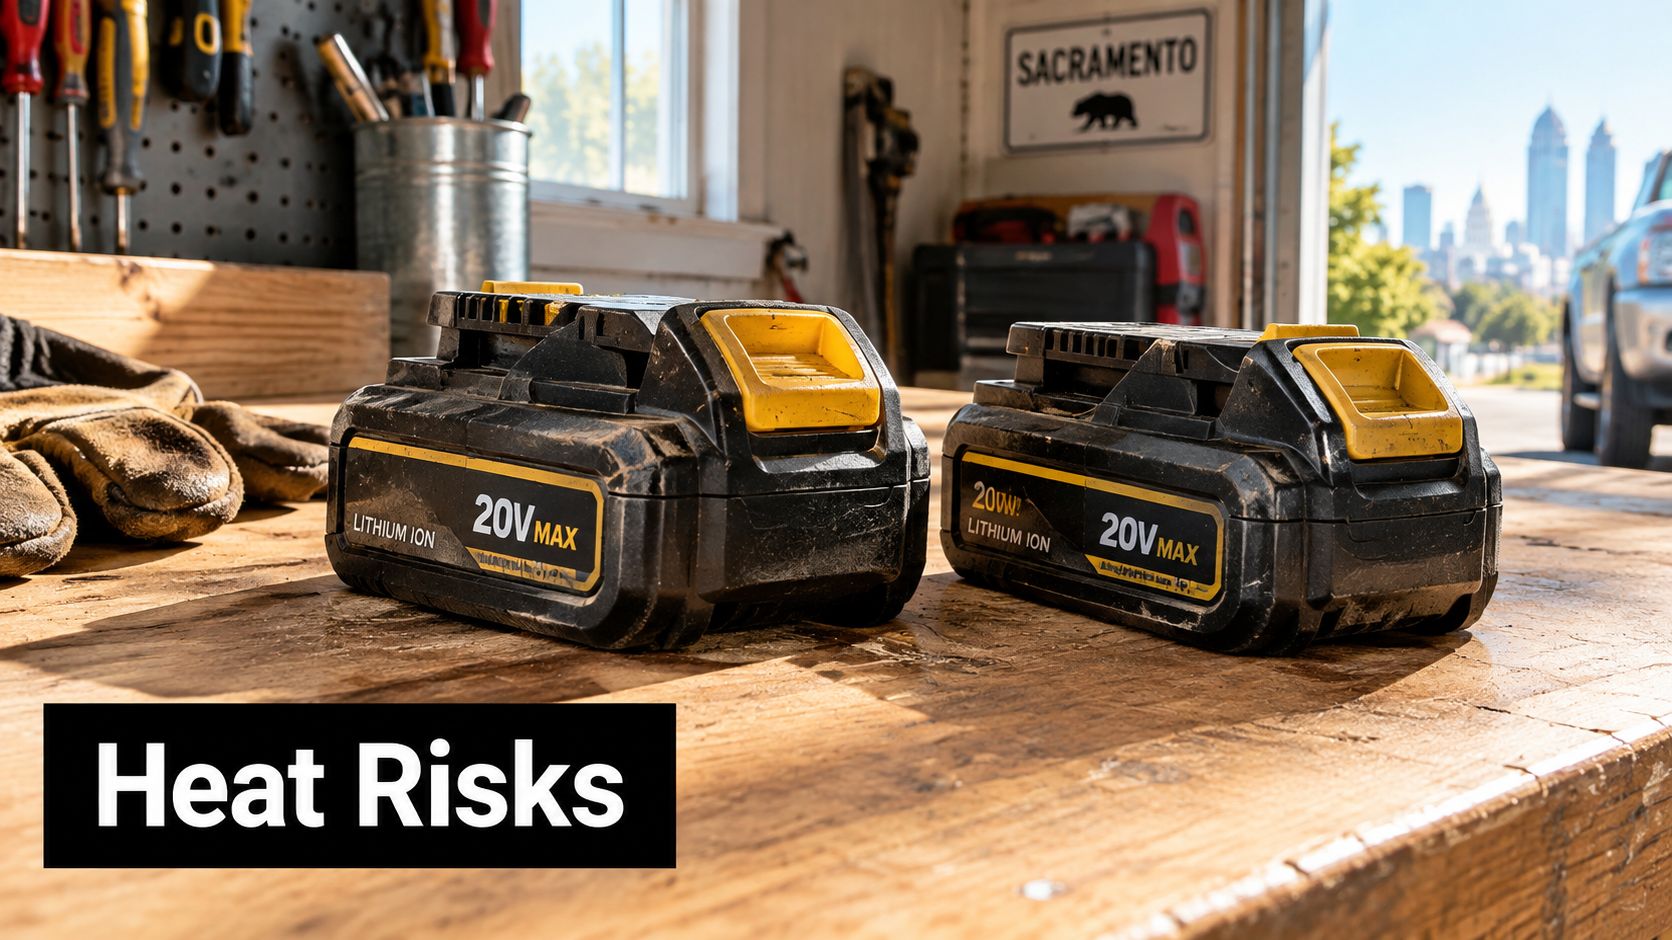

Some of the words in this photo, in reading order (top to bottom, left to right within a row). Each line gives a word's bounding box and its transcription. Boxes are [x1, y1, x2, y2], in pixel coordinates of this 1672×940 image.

[1017, 35, 1197, 86] SACRAMENTO
[354, 513, 407, 542] LITHIUM
[410, 527, 436, 549] ION
[473, 494, 535, 542] 20V
[534, 521, 578, 551] MAX
[968, 518, 1021, 545] LITHIUM
[1026, 532, 1050, 553] ION
[1100, 512, 1158, 555] 20V
[1157, 537, 1199, 566] MAX
